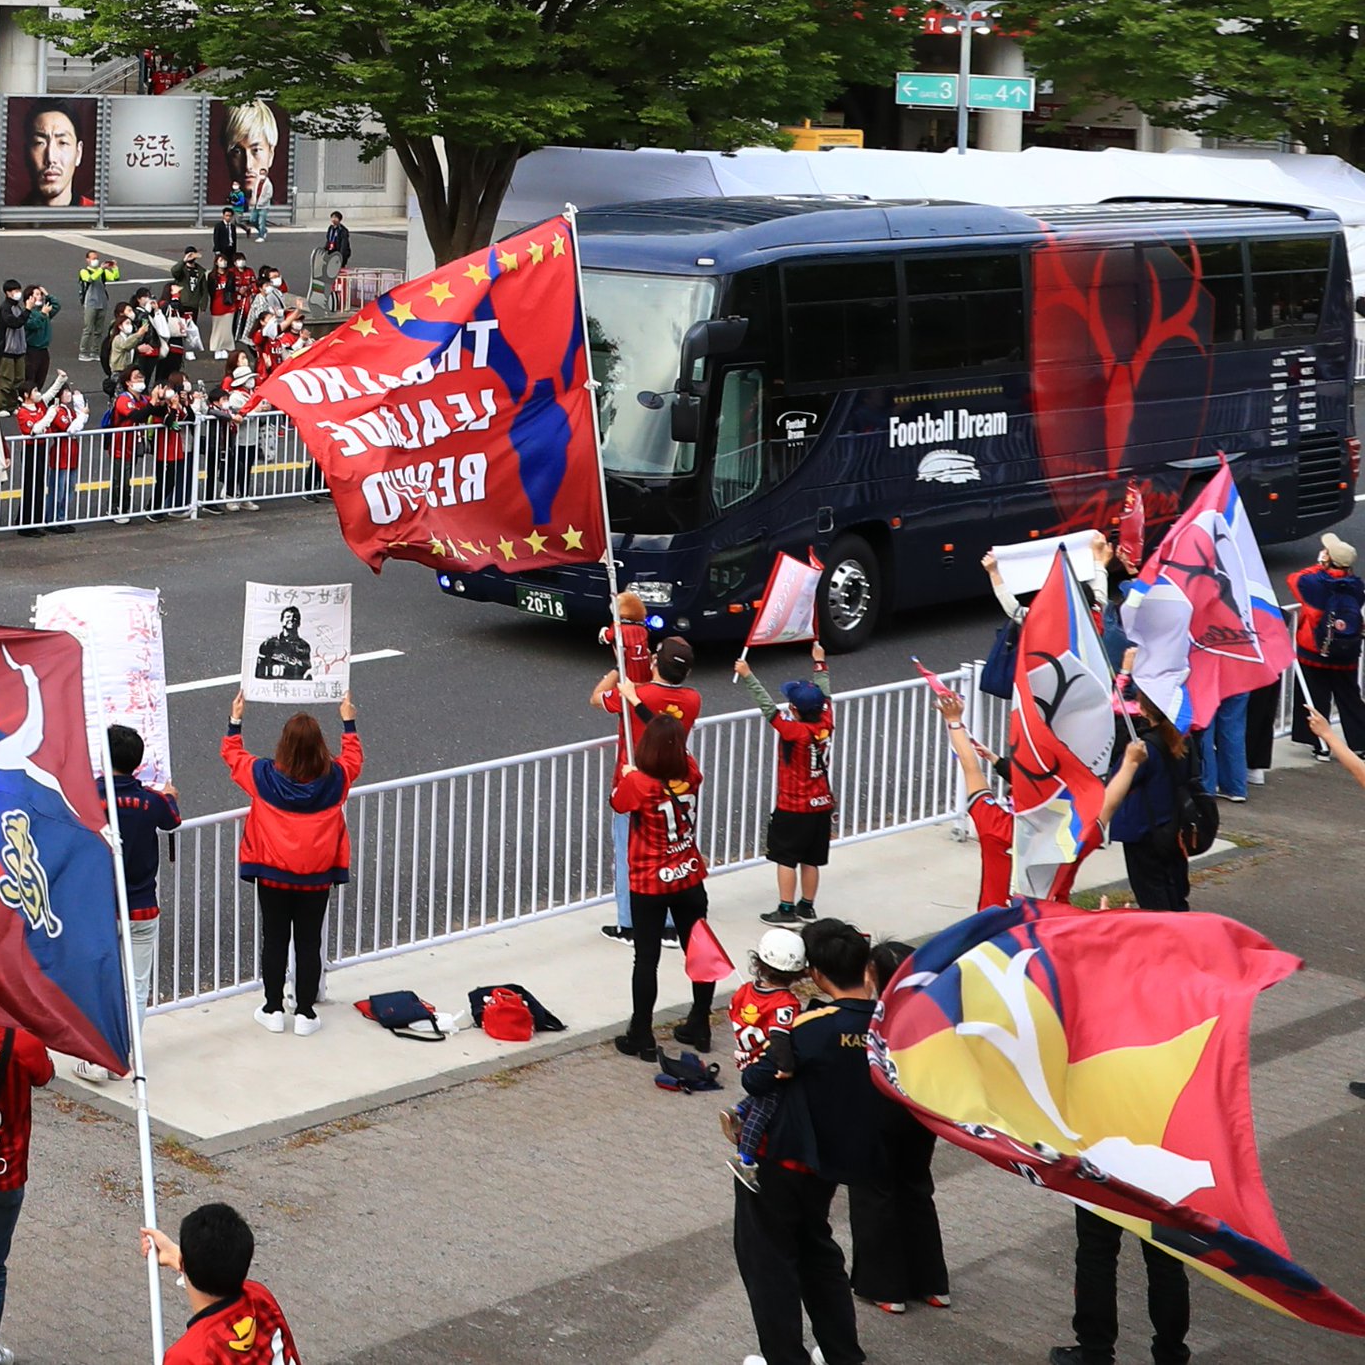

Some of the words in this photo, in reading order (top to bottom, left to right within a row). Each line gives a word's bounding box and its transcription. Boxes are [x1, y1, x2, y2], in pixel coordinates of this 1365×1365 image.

[940, 82, 952, 99] 3
[995, 85, 1009, 102] 4
[133, 134, 175, 150] 今こそ、
[126, 151, 181, 168] ひとつに。
[785, 418, 807, 429] Football
[889, 410, 954, 448] Football
[958, 408, 1007, 439] Dream
[787, 430, 805, 440] Dream
[526, 596, 564, 617] 20-18
